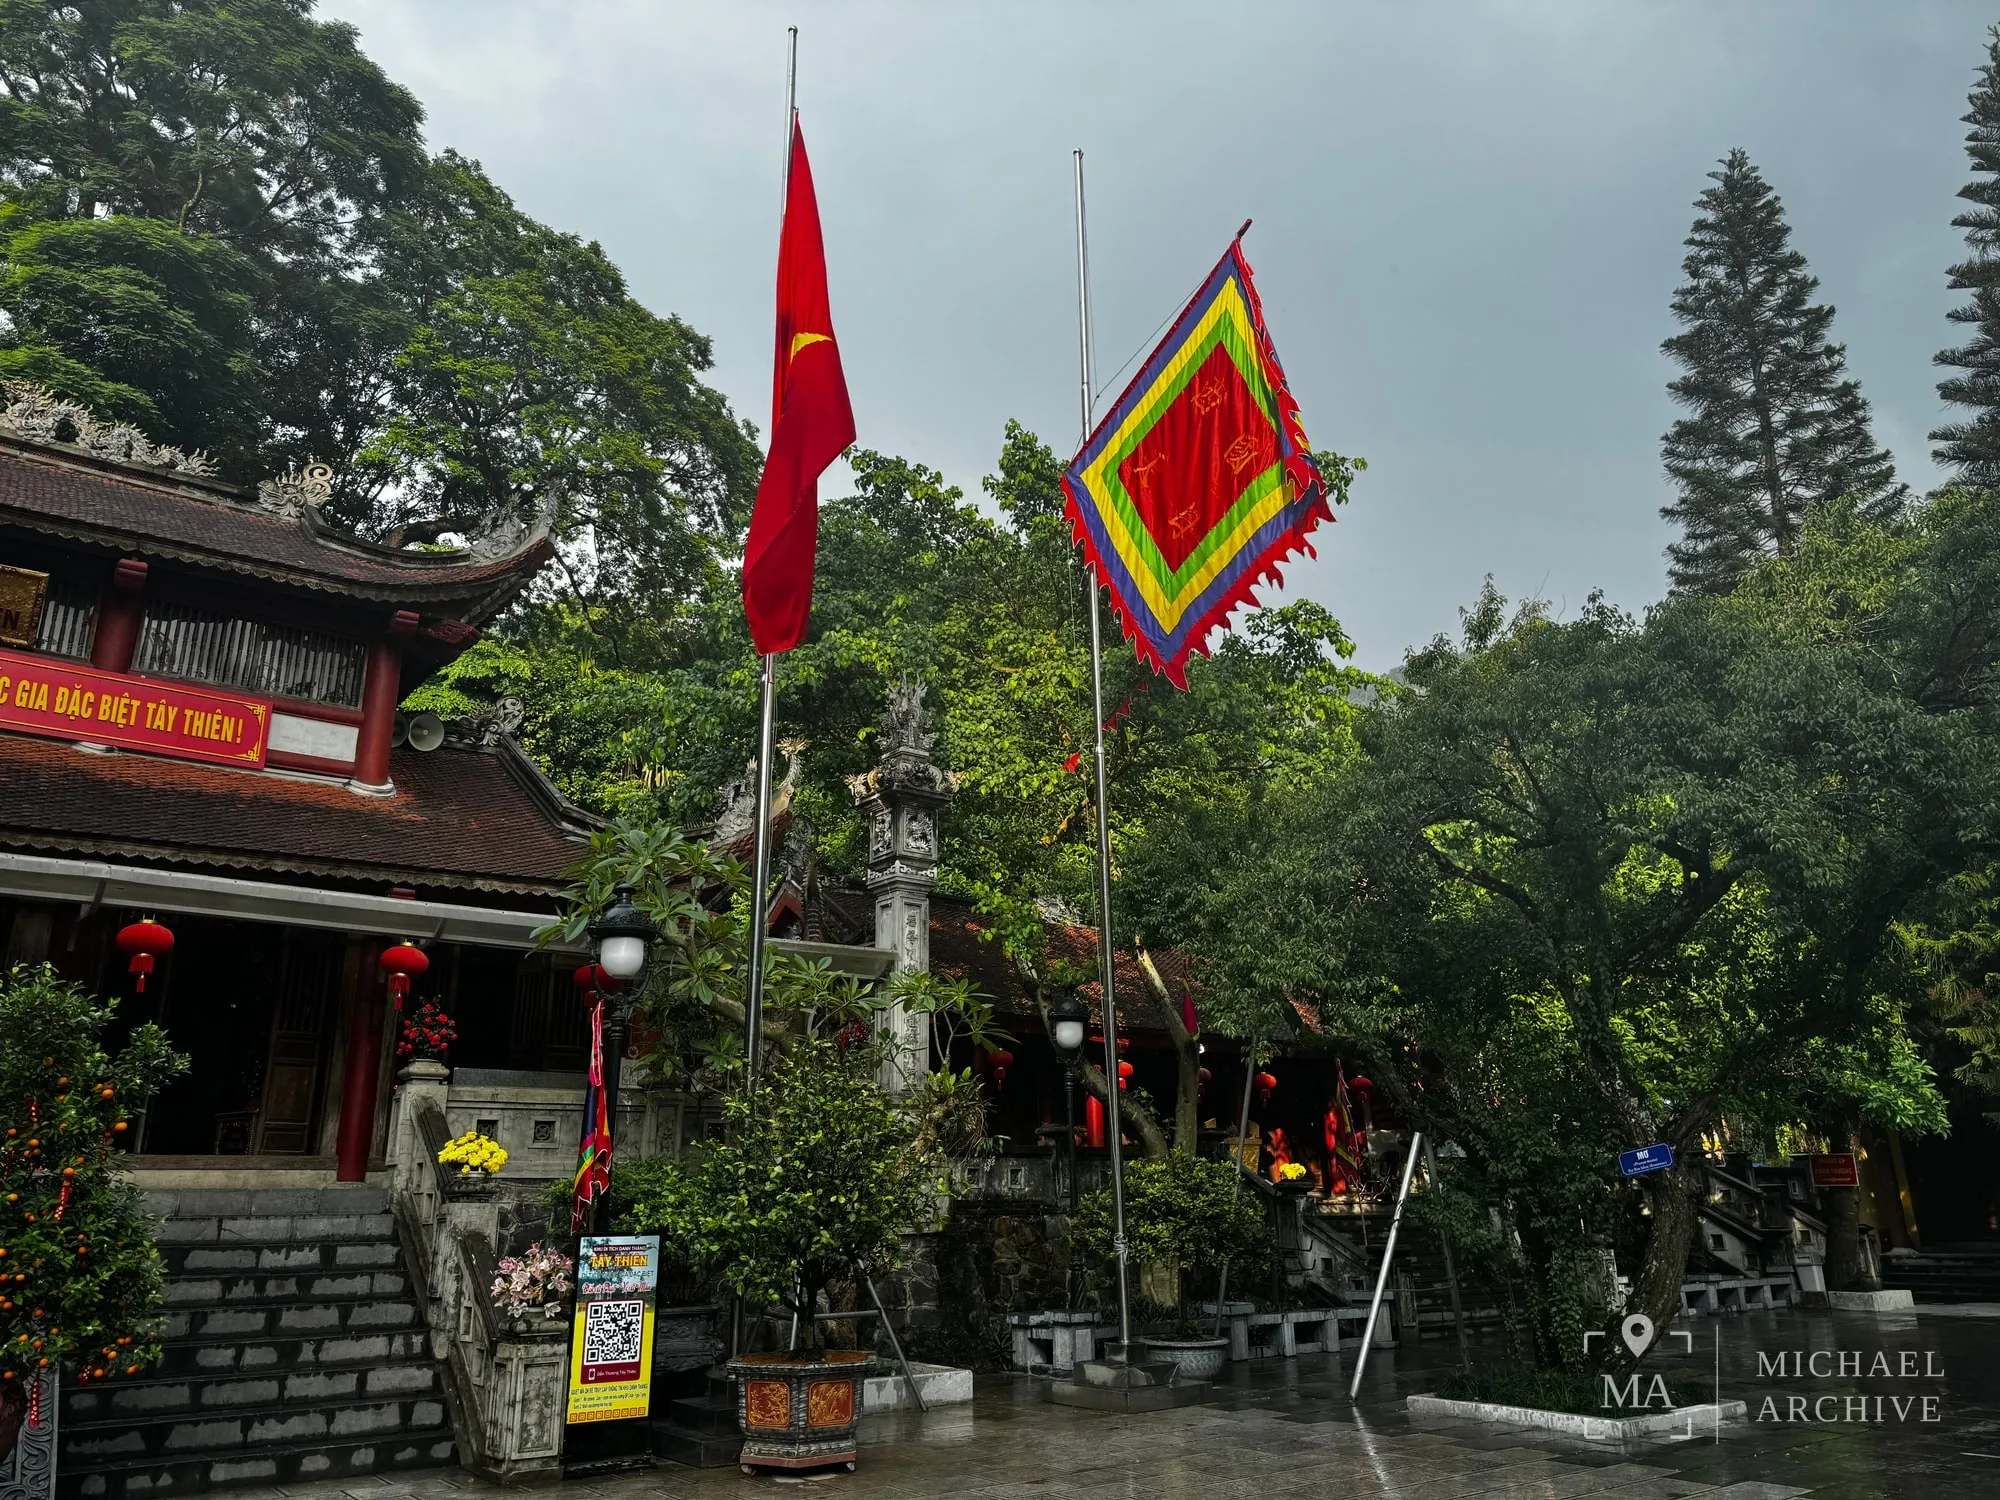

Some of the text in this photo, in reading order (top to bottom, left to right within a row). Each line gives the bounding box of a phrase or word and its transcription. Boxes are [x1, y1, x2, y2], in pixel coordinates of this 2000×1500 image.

[0, 607, 21, 631] N
[15, 679, 48, 711] GIA
[54, 684, 95, 722] ĐẶC
[98, 692, 141, 729] BIỆT
[146, 701, 179, 733] TÂY
[591, 1253, 648, 1268] TÂY THIÊN
